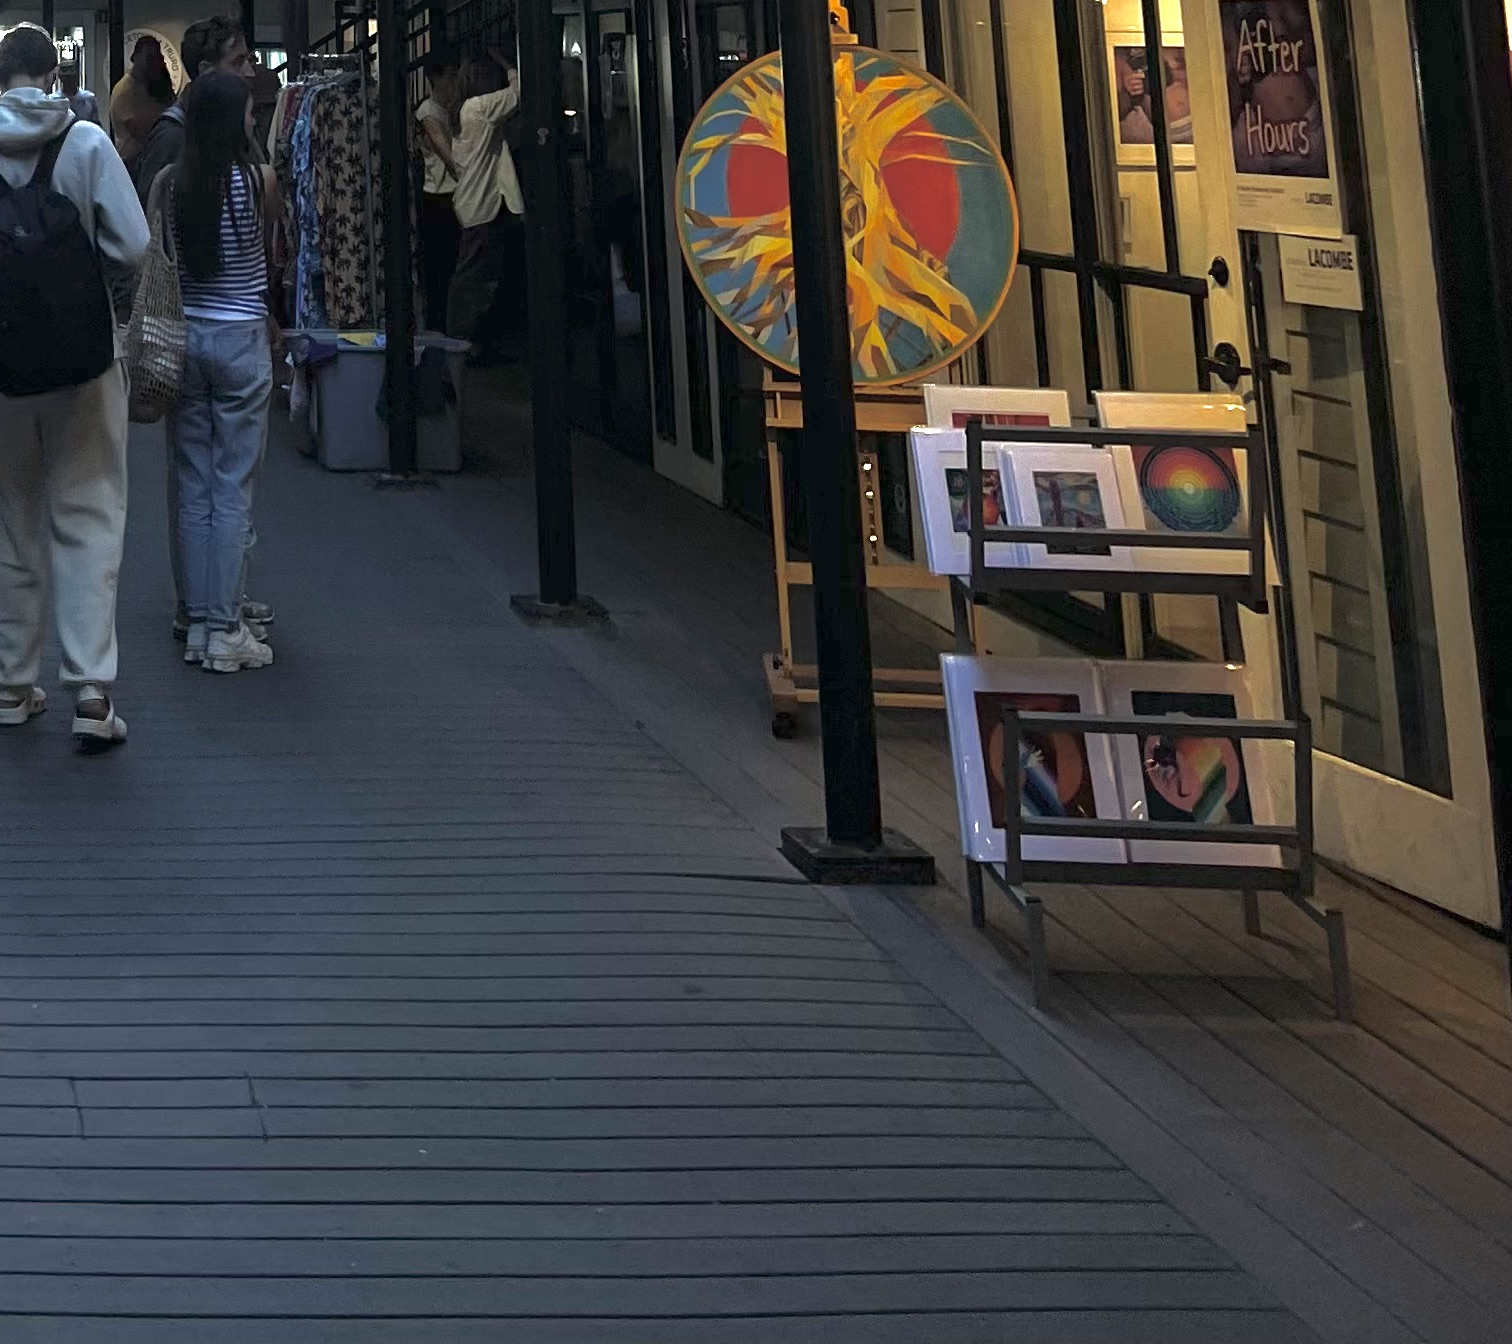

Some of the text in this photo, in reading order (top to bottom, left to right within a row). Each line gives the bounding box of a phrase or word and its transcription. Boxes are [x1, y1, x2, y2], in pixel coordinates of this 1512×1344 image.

[162, 42, 179, 72] TRURO
[1237, 19, 1304, 74] After
[1245, 103, 1310, 156] Hours
